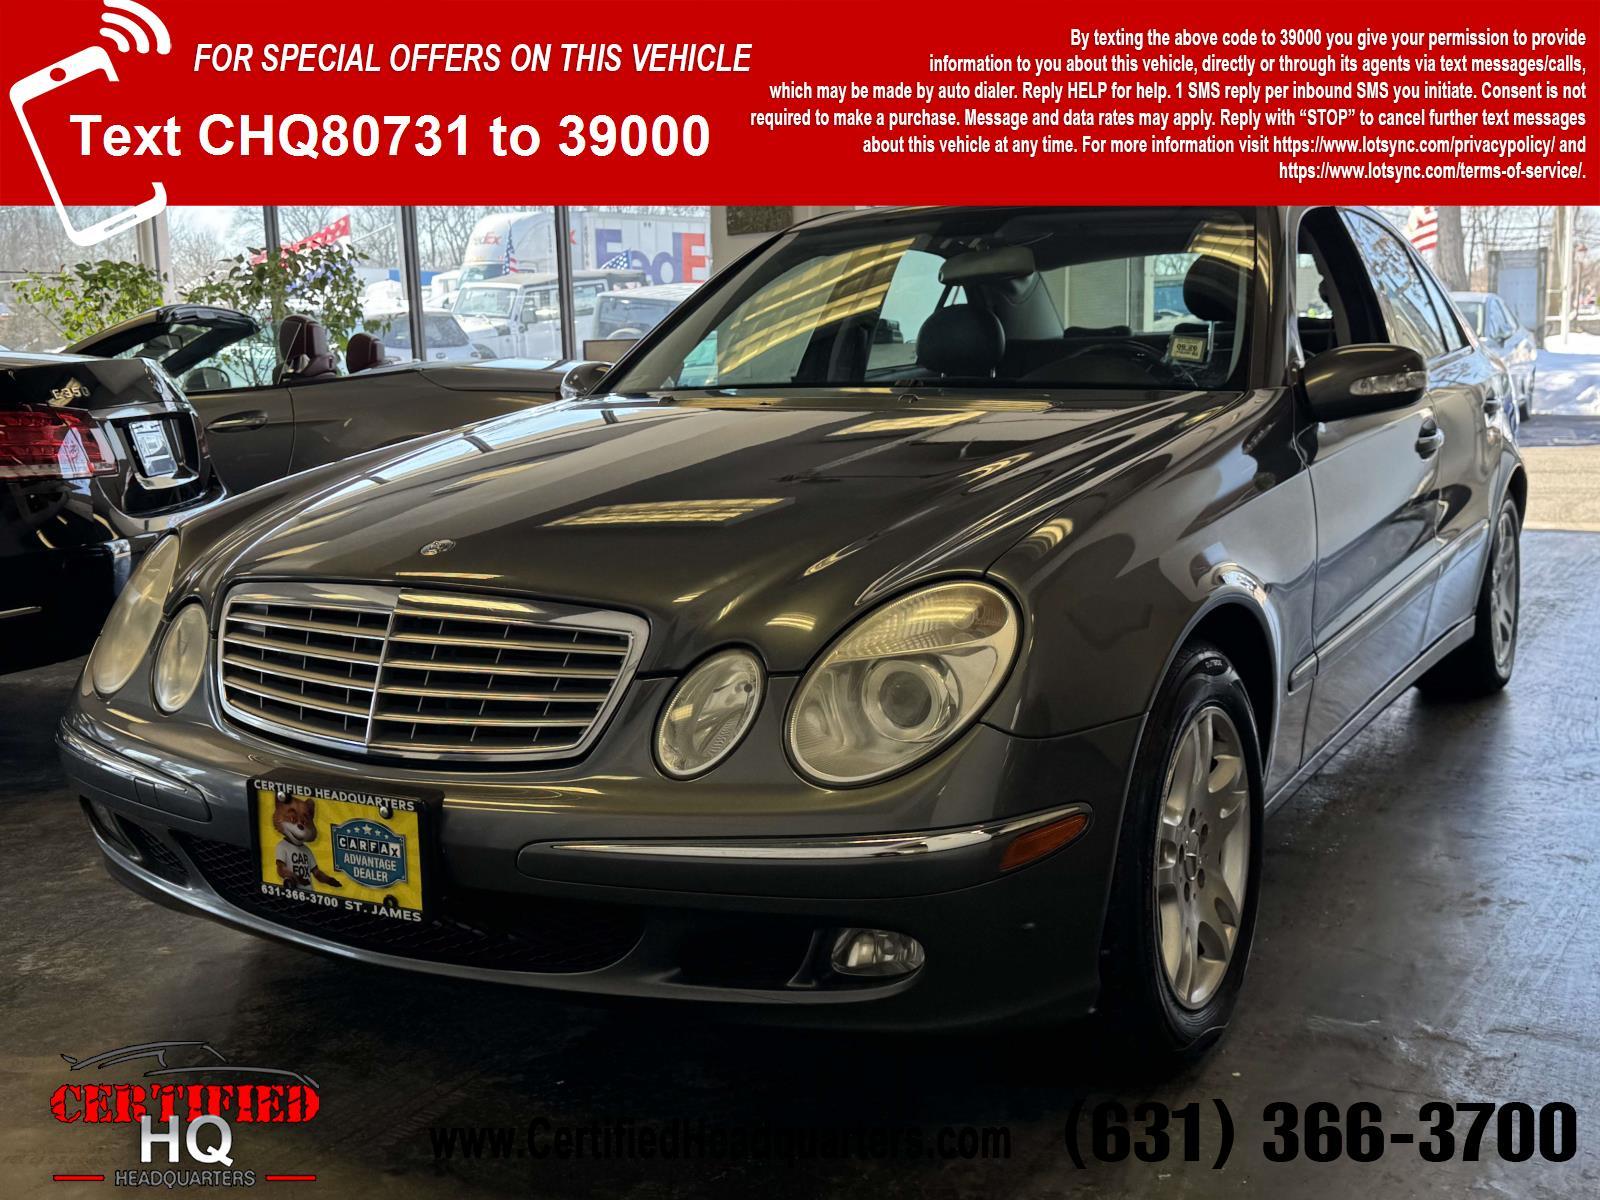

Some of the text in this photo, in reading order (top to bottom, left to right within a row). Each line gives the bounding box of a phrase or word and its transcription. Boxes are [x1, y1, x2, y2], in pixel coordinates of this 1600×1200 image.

[595, 228, 706, 285] FedE
[254, 779, 415, 811] CERTIFIED HEADQUARTERS
[338, 836, 400, 858] CARFAX
[291, 852, 309, 865] CAR
[344, 852, 397, 871] ADVANTAGE
[353, 866, 388, 883] DEALER
[261, 884, 422, 922] 631-366-3700 ST. JAMES
